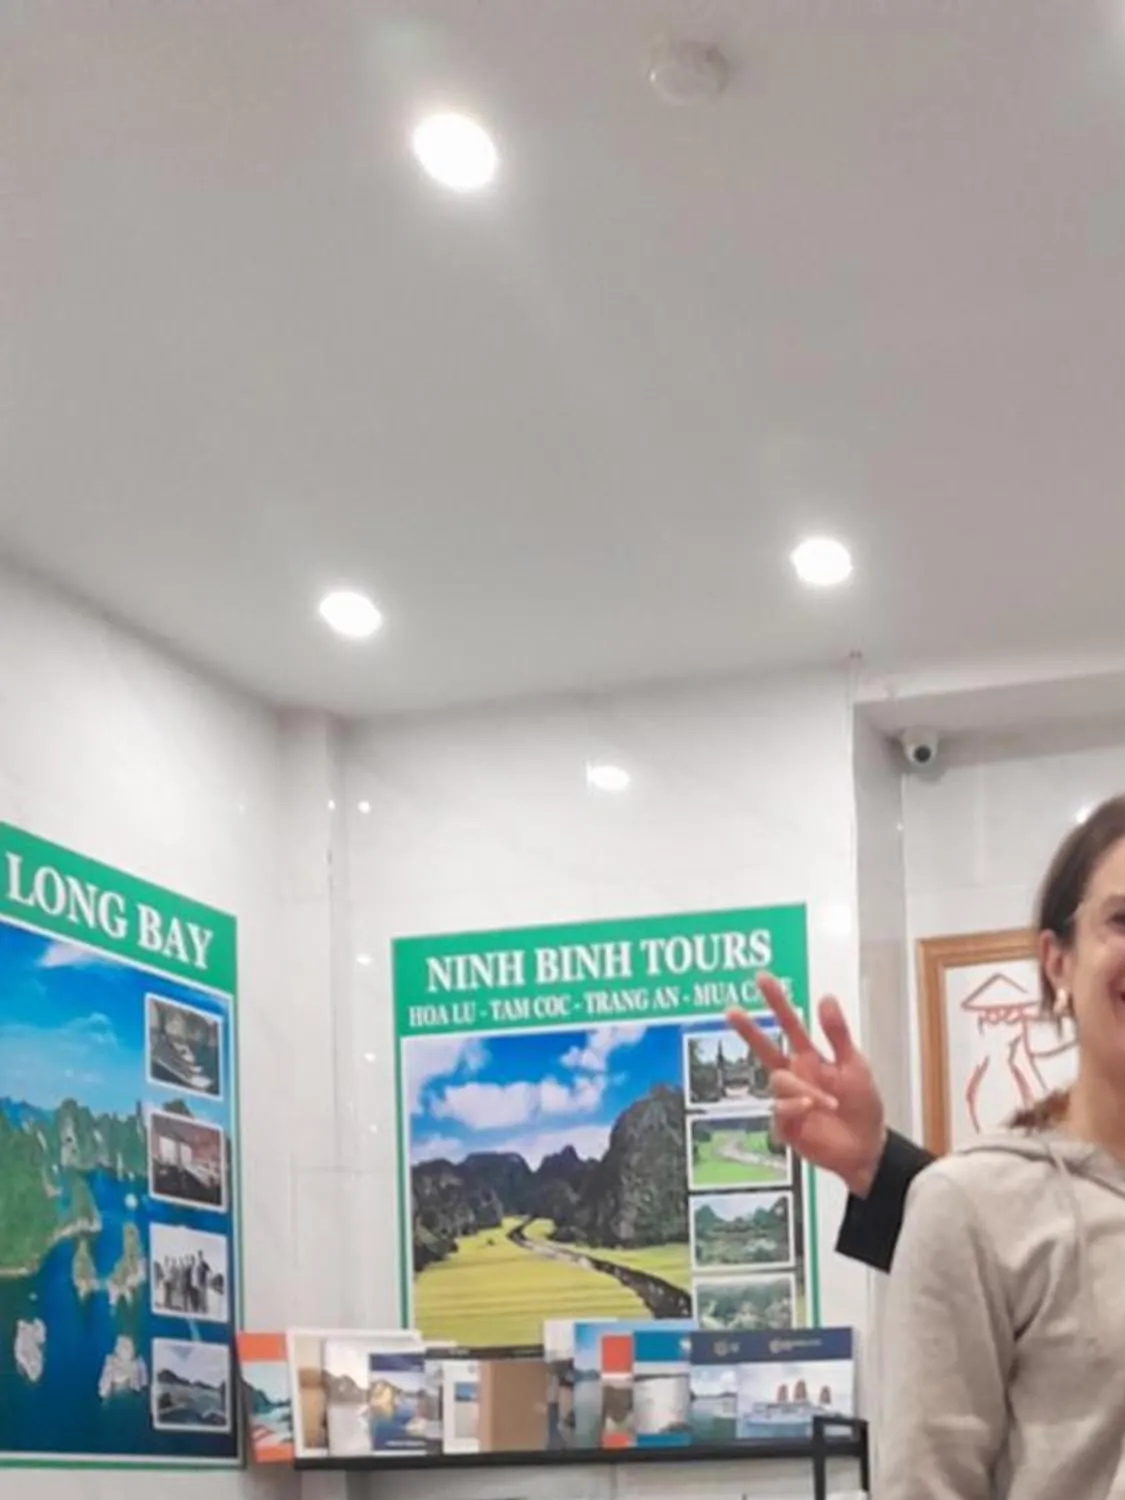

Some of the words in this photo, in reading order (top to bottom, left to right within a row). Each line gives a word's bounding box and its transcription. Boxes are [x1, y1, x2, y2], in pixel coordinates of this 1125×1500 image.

[6, 851, 128, 939] LONG
[136, 902, 214, 970] BAY
[426, 949, 526, 993] NINH
[535, 941, 632, 985] BINH
[640, 928, 772, 976] TOURS
[409, 1003, 449, 1028] HOA
[452, 1001, 475, 1025] LU
[491, 996, 530, 1022] TAM
[533, 993, 570, 1018] COC
[584, 987, 649, 1015] TRANG
[653, 985, 681, 1009] AN
[693, 981, 739, 1008] MUA
